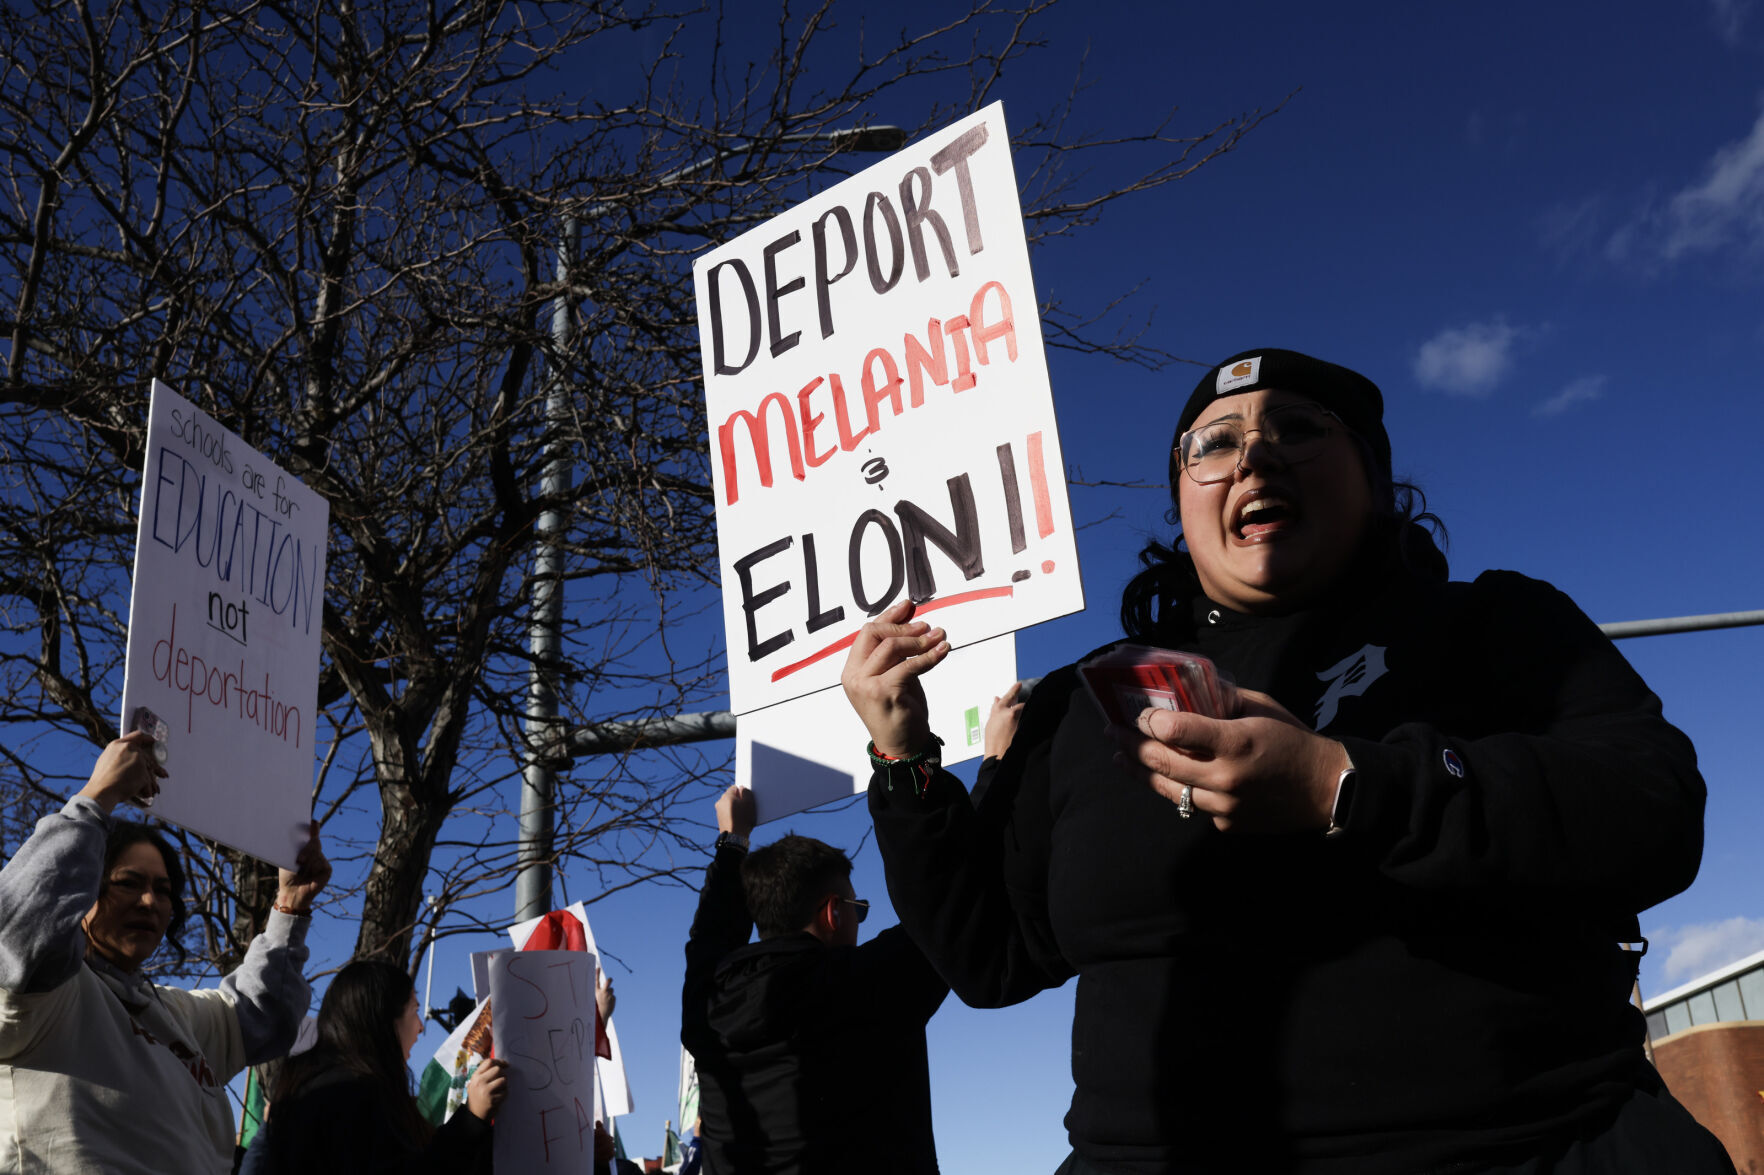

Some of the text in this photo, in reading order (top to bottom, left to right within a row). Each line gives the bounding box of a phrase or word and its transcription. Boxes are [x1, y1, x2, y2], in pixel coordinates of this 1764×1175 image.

[707, 121, 989, 376] DEPORT
[718, 281, 1018, 506] MELANIA
[153, 446, 317, 634] EDUCATION
[241, 463, 266, 499] are
[272, 476, 300, 519] for
[152, 602, 301, 750] deportation
[207, 591, 250, 644] not
